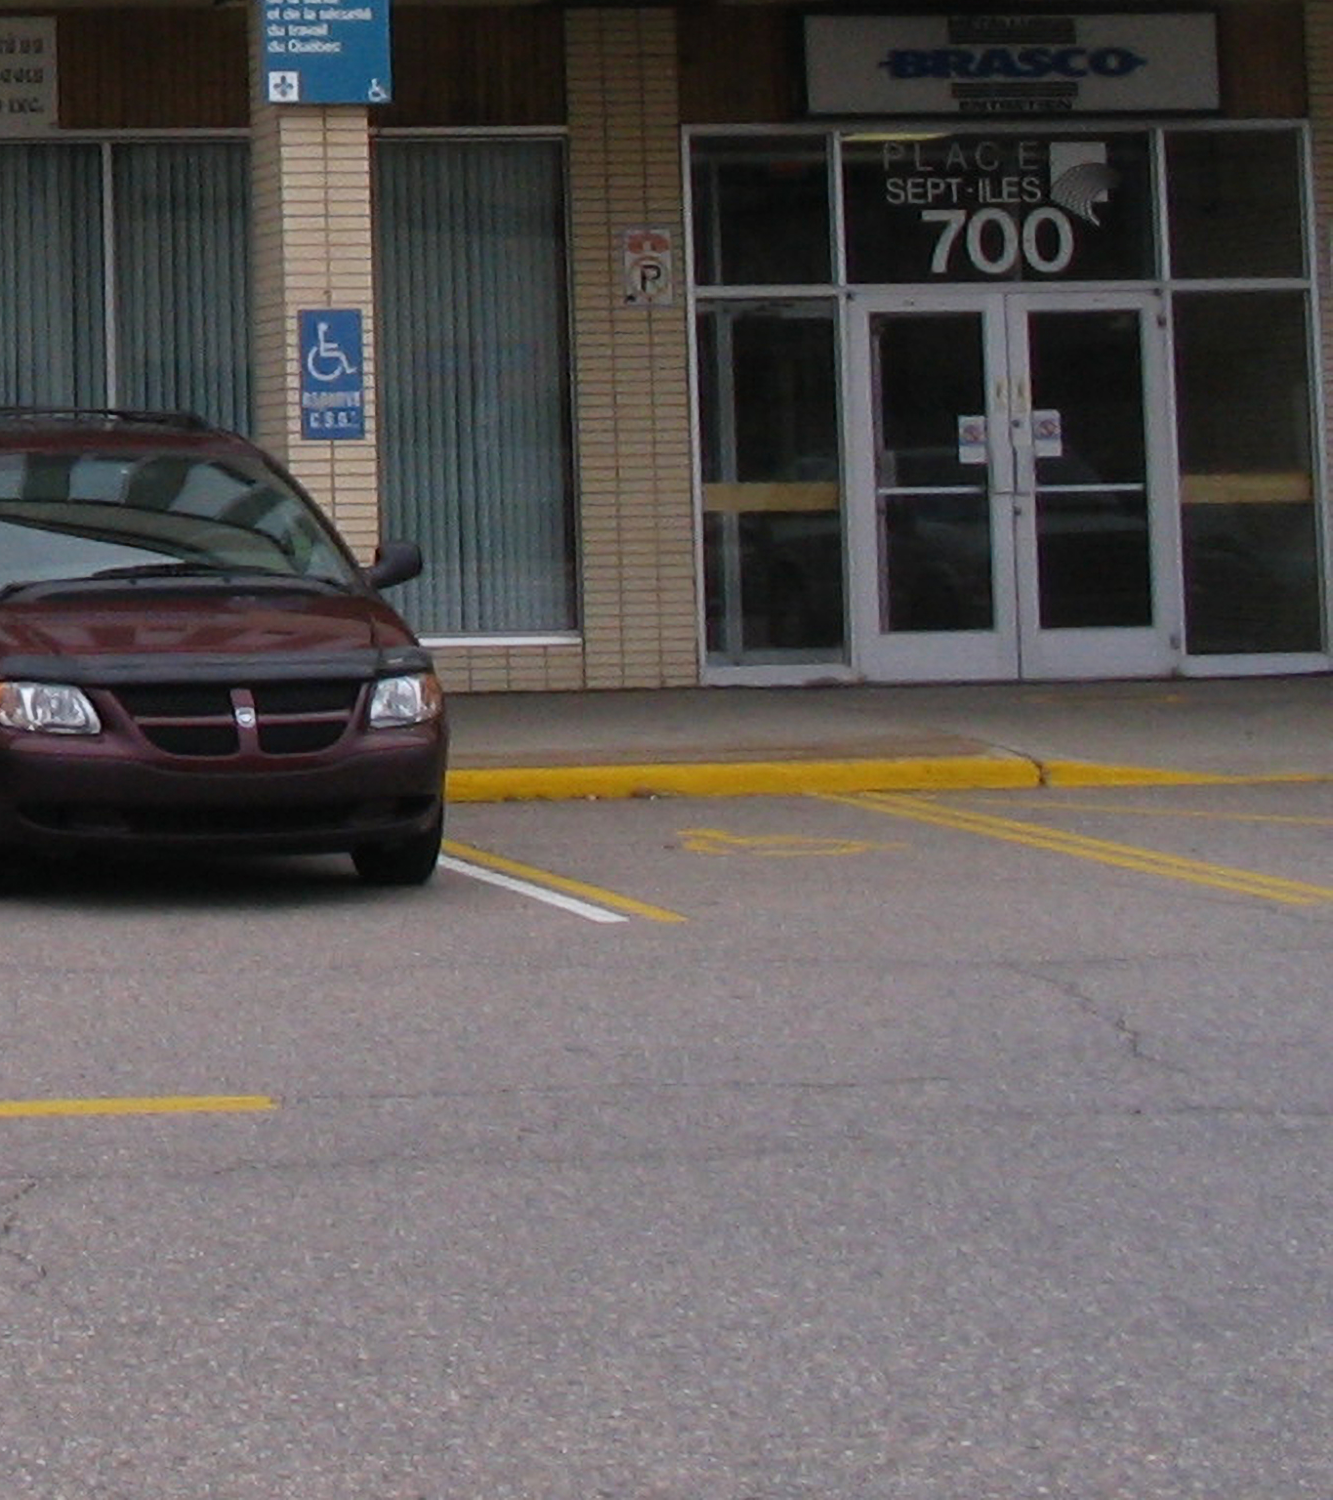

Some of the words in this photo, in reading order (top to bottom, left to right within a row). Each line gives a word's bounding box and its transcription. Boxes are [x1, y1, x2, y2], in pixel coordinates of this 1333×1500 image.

[885, 47, 1141, 80] BRASCO
[883, 141, 1039, 172] PLACE
[920, 206, 1075, 274] 700
